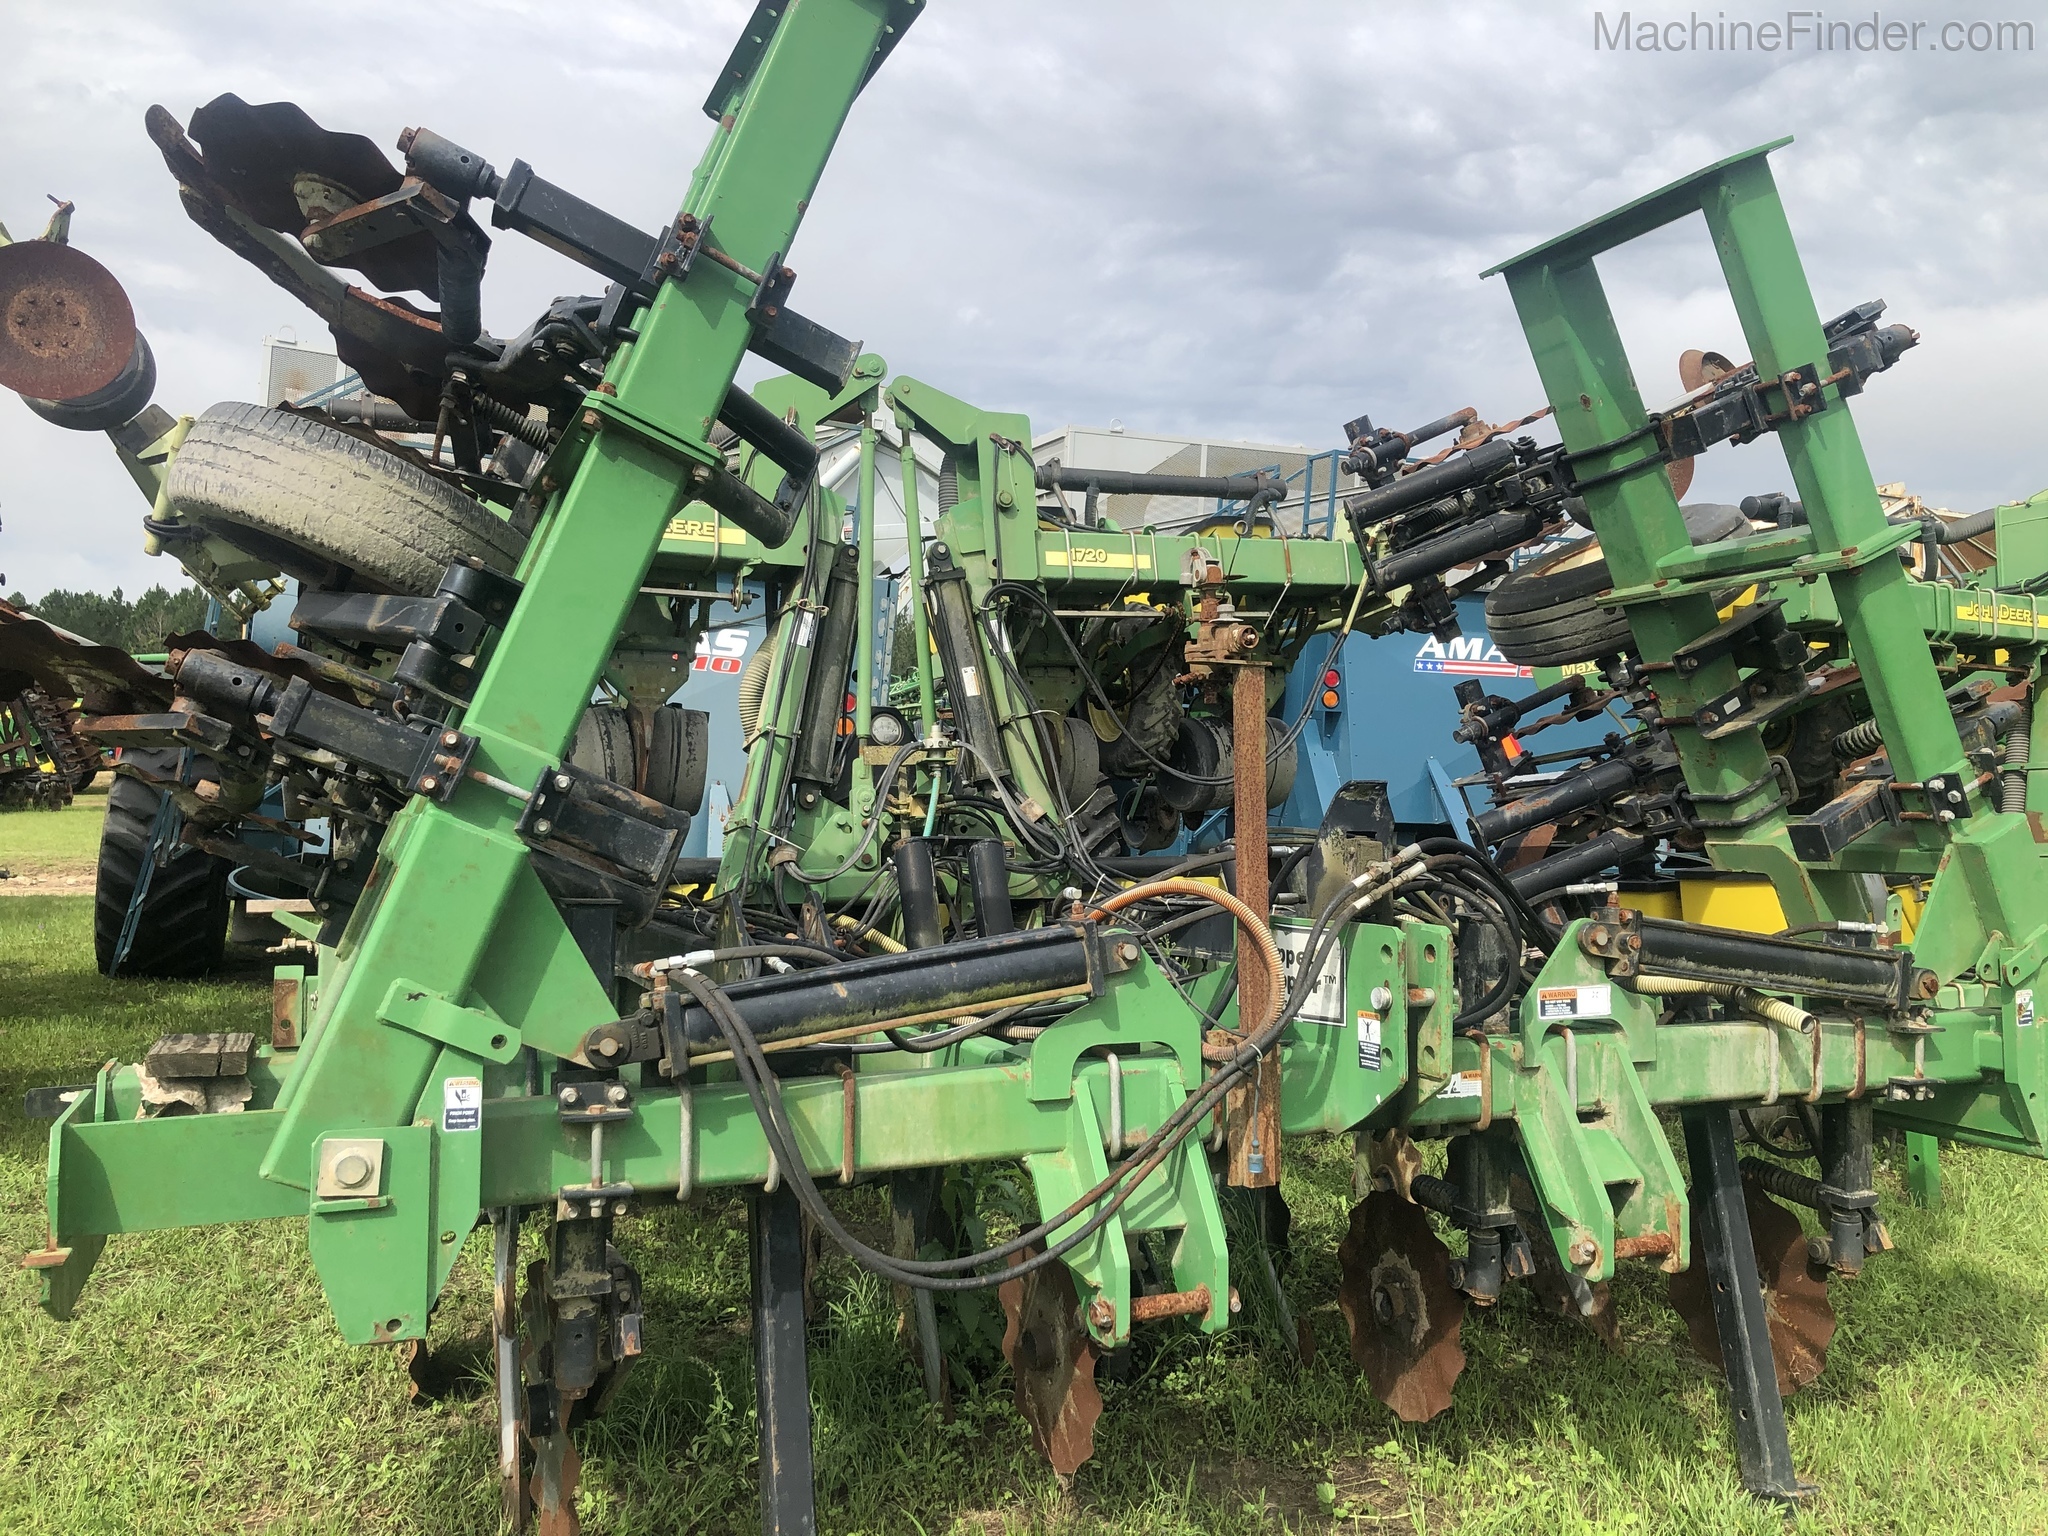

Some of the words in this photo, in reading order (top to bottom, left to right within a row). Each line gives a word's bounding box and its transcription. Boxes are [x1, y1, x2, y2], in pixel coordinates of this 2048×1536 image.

[1070, 547, 1108, 563] 1720
[2000, 604, 2039, 623] DEER
[1547, 990, 1576, 999] WARNING
